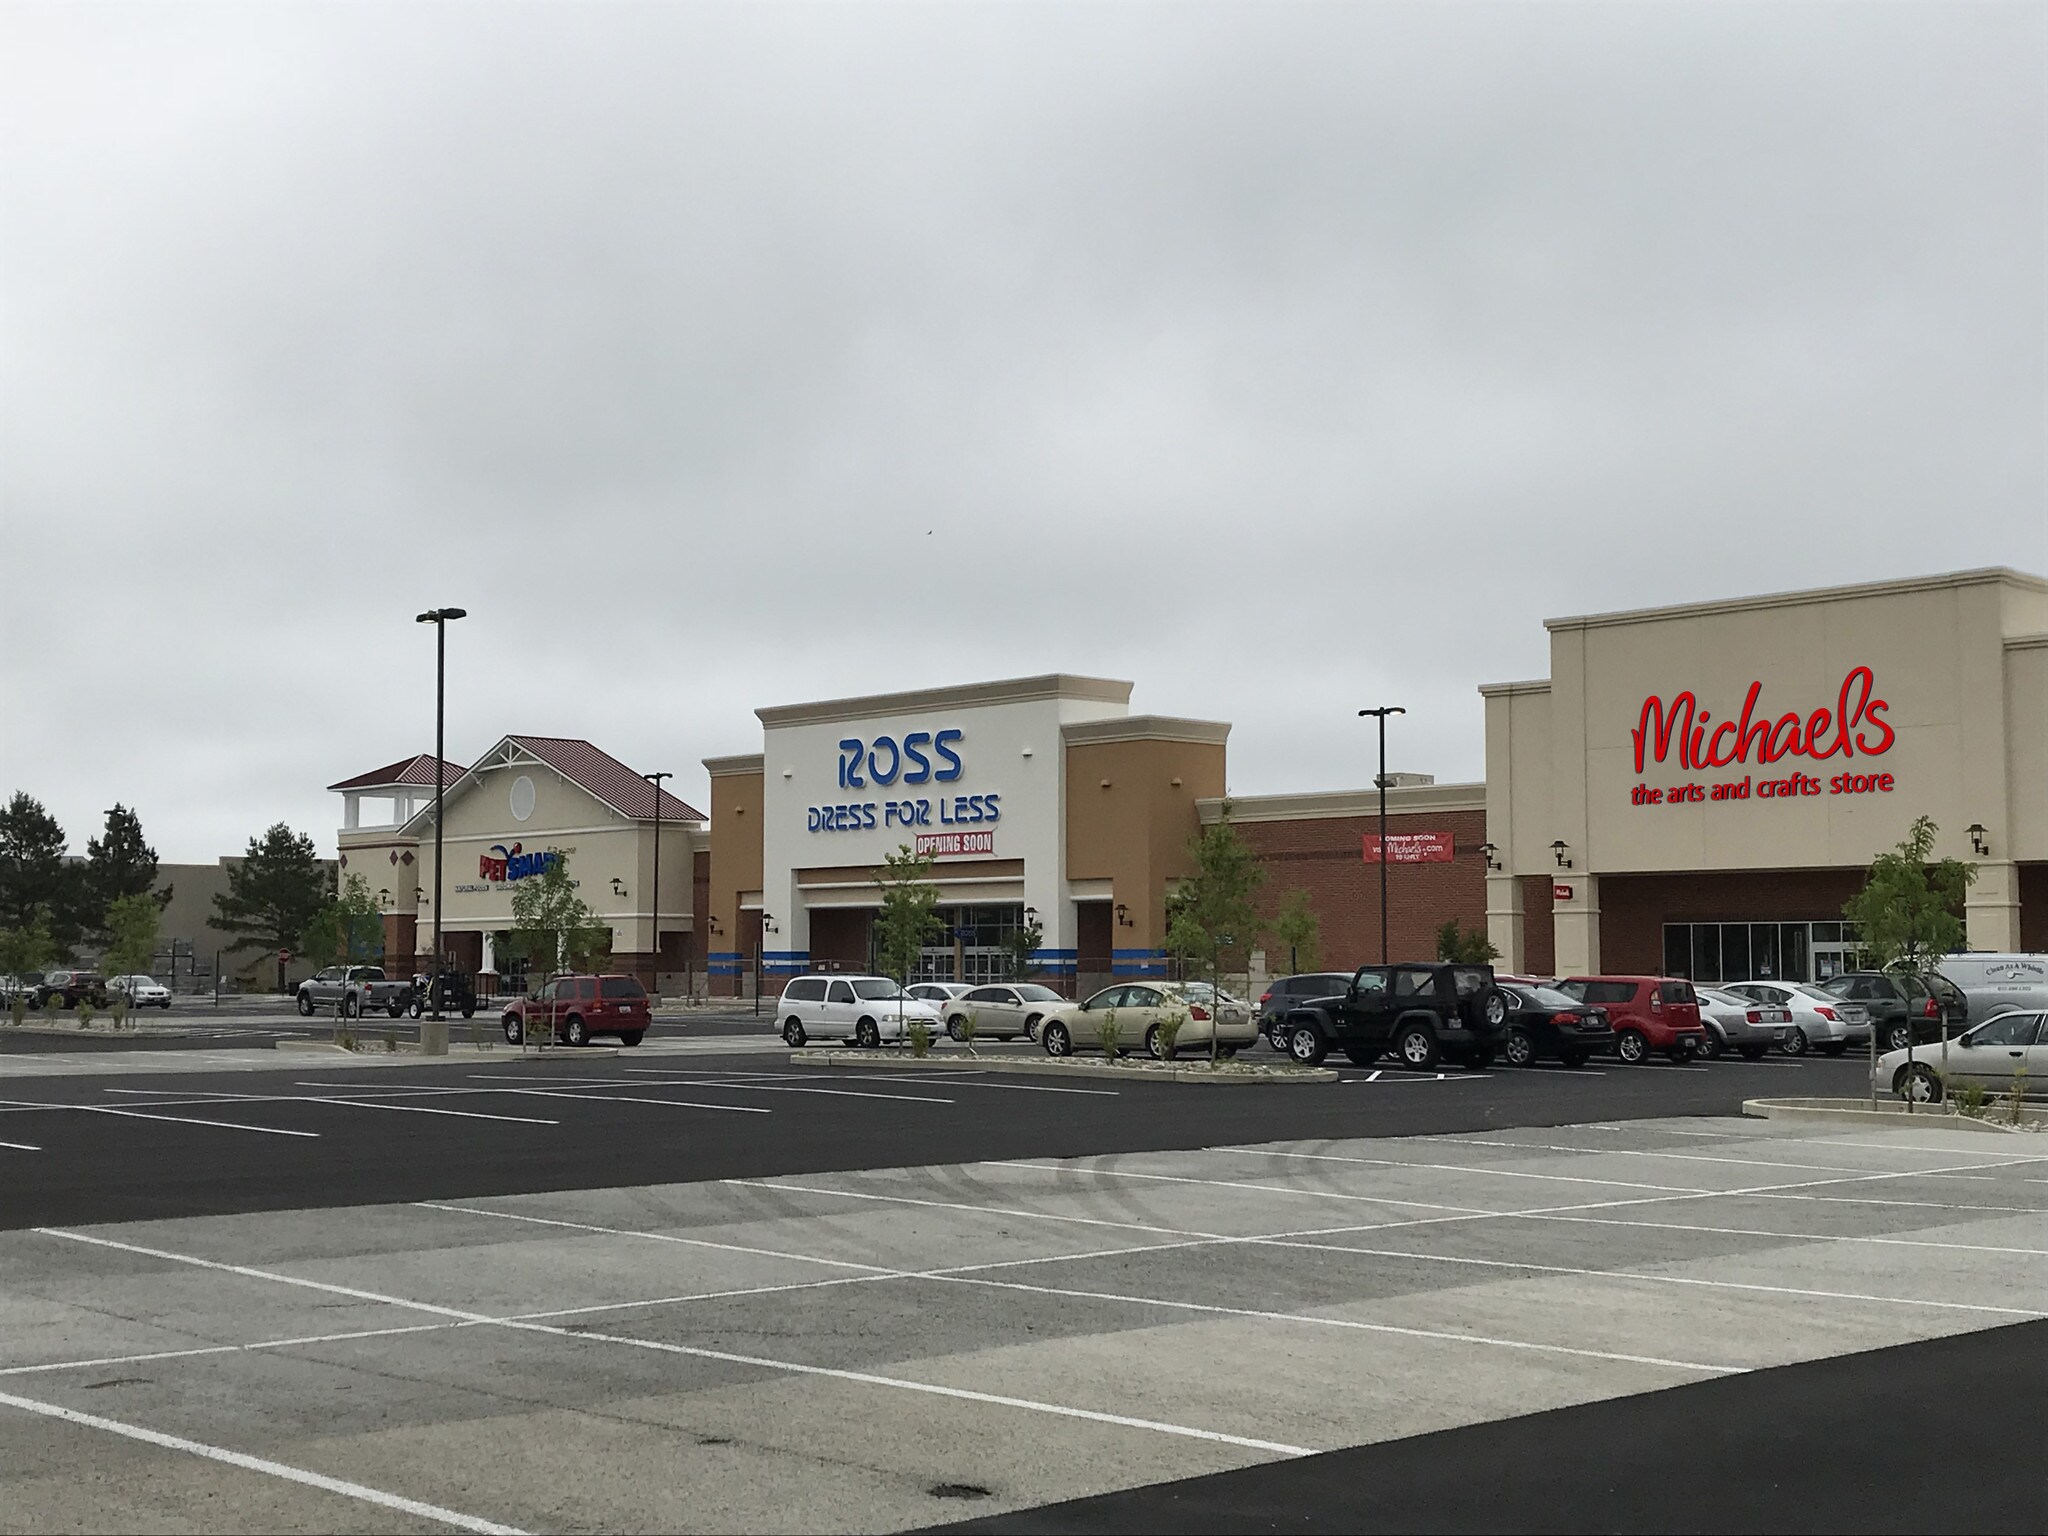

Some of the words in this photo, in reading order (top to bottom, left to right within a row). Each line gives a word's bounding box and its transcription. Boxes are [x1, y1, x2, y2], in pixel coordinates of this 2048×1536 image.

[1631, 666, 1895, 774] Michaels
[839, 729, 963, 788] ROSS
[1631, 784, 1662, 805] the
[1667, 784, 1704, 803] arts
[1711, 776, 1751, 800] and
[1757, 772, 1821, 798] crafts
[1830, 772, 1894, 794] store
[808, 803, 878, 832] DRESS
[885, 799, 931, 826] FOR
[941, 794, 1000, 824] LESS
[917, 836, 961, 854] OPENING
[963, 834, 992, 851] SOON
